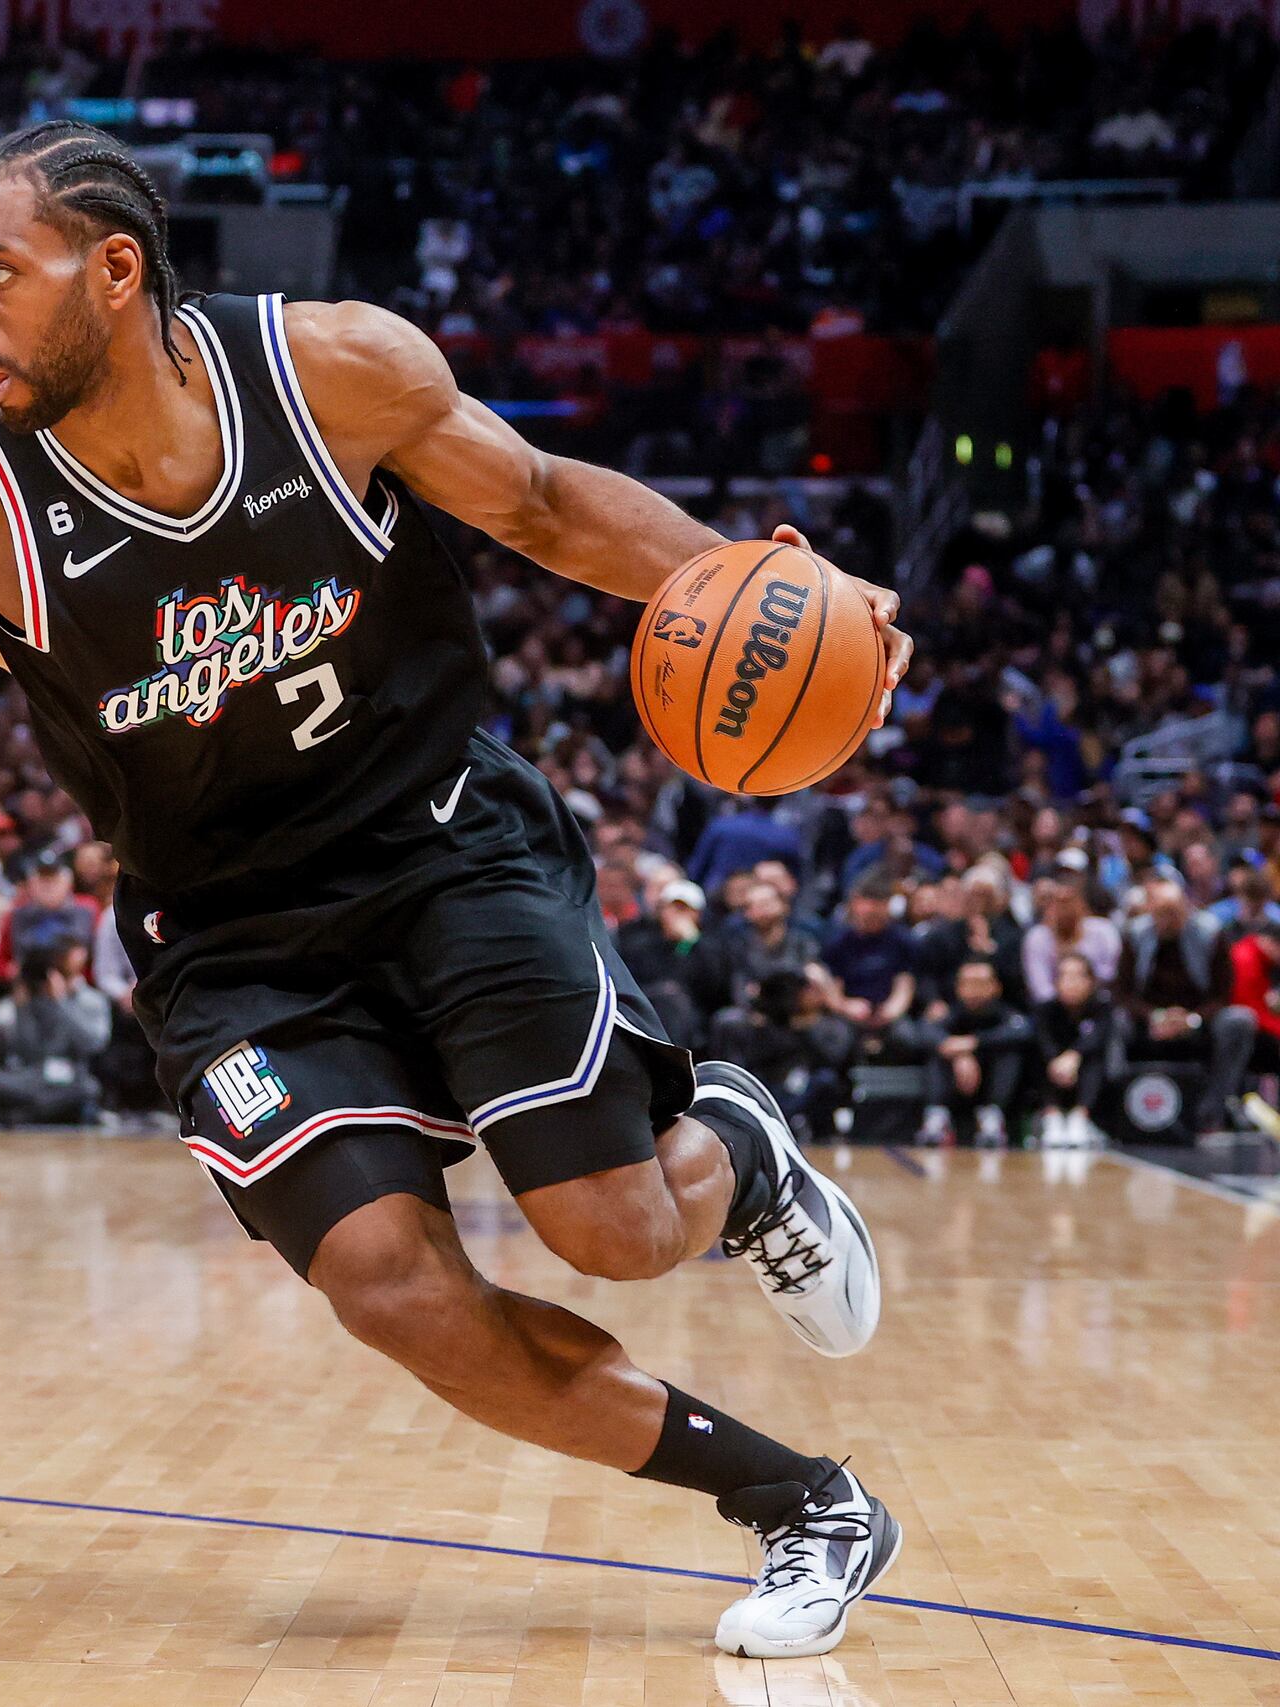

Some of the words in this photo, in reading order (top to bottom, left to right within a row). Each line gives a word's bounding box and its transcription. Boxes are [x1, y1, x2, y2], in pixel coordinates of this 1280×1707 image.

[46, 500, 75, 536] 6
[243, 475, 312, 519] honey
[100, 583, 357, 729] angeles
[157, 580, 261, 665] los
[713, 578, 812, 739] Wilson
[274, 662, 351, 752] 2
